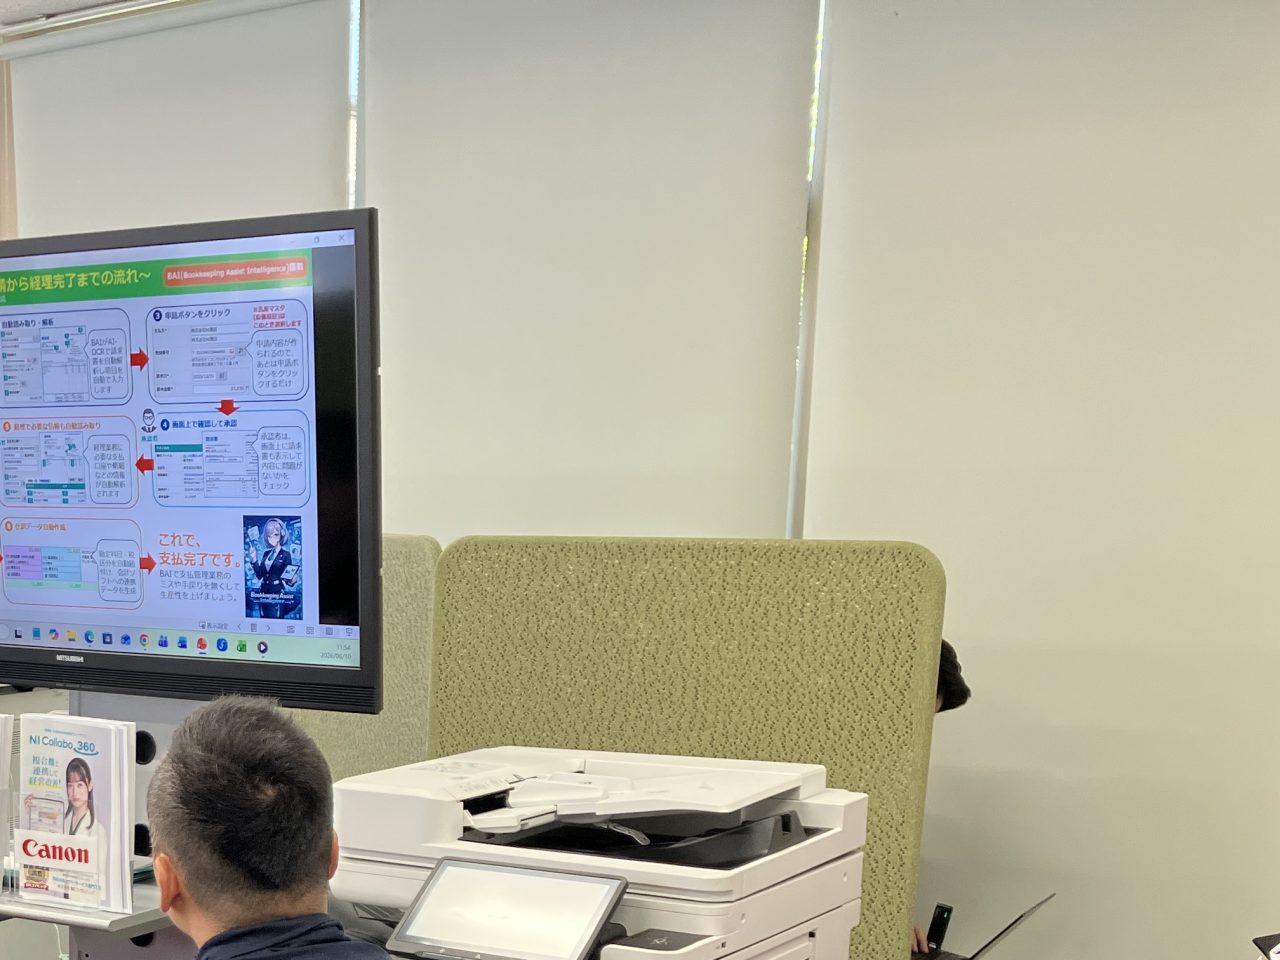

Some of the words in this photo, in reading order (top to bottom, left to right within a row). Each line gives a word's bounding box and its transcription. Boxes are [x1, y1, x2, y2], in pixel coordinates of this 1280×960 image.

[159, 532, 201, 548] これで、
[159, 552, 241, 568] 支払完了です。
[29, 735, 40, 745] NI
[41, 735, 74, 750] Collabo
[77, 740, 96, 753] 360
[21, 838, 90, 864] Canon
